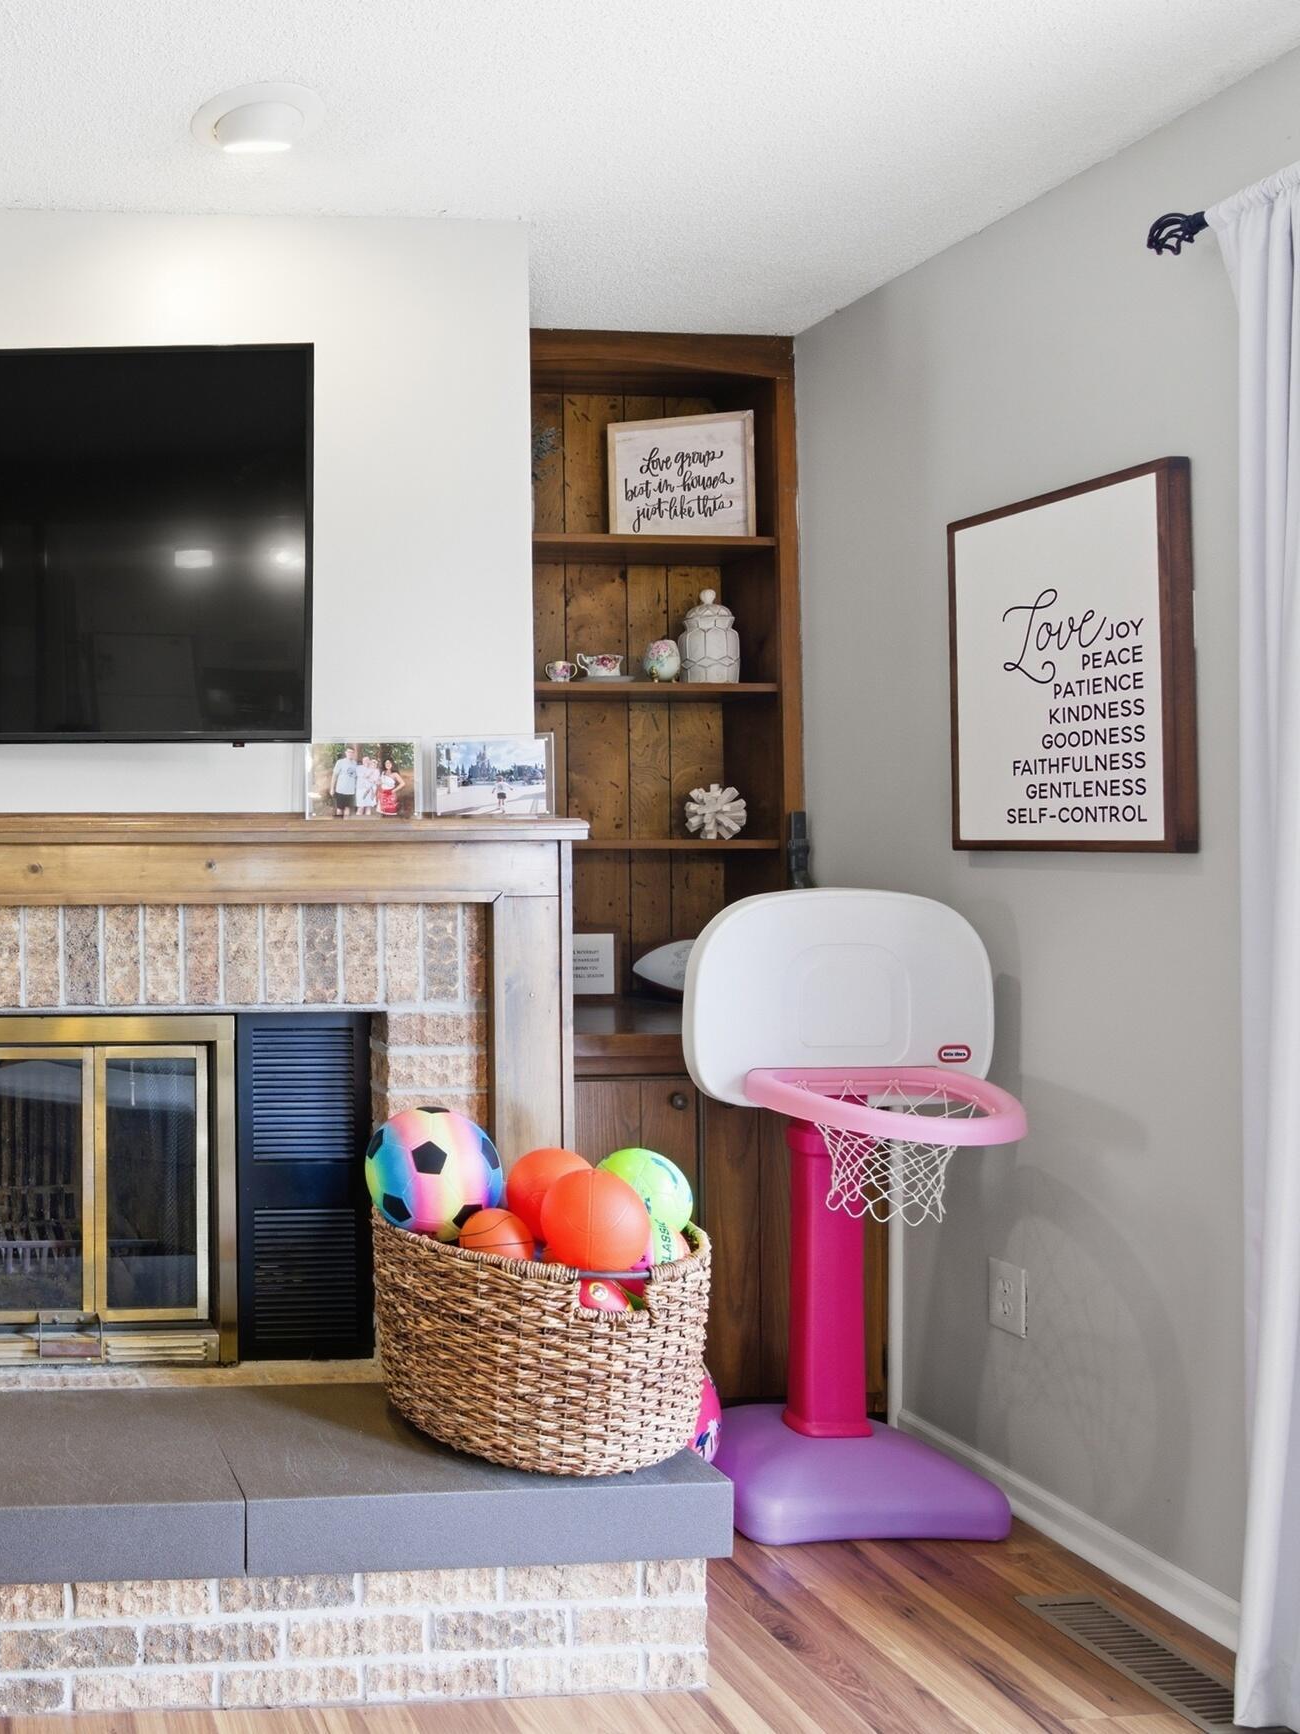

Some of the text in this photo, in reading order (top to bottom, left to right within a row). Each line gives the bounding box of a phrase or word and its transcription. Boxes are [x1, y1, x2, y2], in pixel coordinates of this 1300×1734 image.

[639, 447, 724, 476] Love grows
[624, 470, 735, 501] best in houses
[632, 494, 733, 533] just like this
[1002, 588, 1144, 684] Love JOY
[1081, 645, 1144, 671] PEACE
[1053, 672, 1144, 700] PATIENCE
[1049, 698, 1145, 725] KINDNESS
[1041, 725, 1146, 750] GOODNESS
[1012, 751, 1147, 777] FAITHFULNESS
[1025, 778, 1147, 800] GENTLENESS
[1006, 804, 1148, 824] SELF-CONTROL
